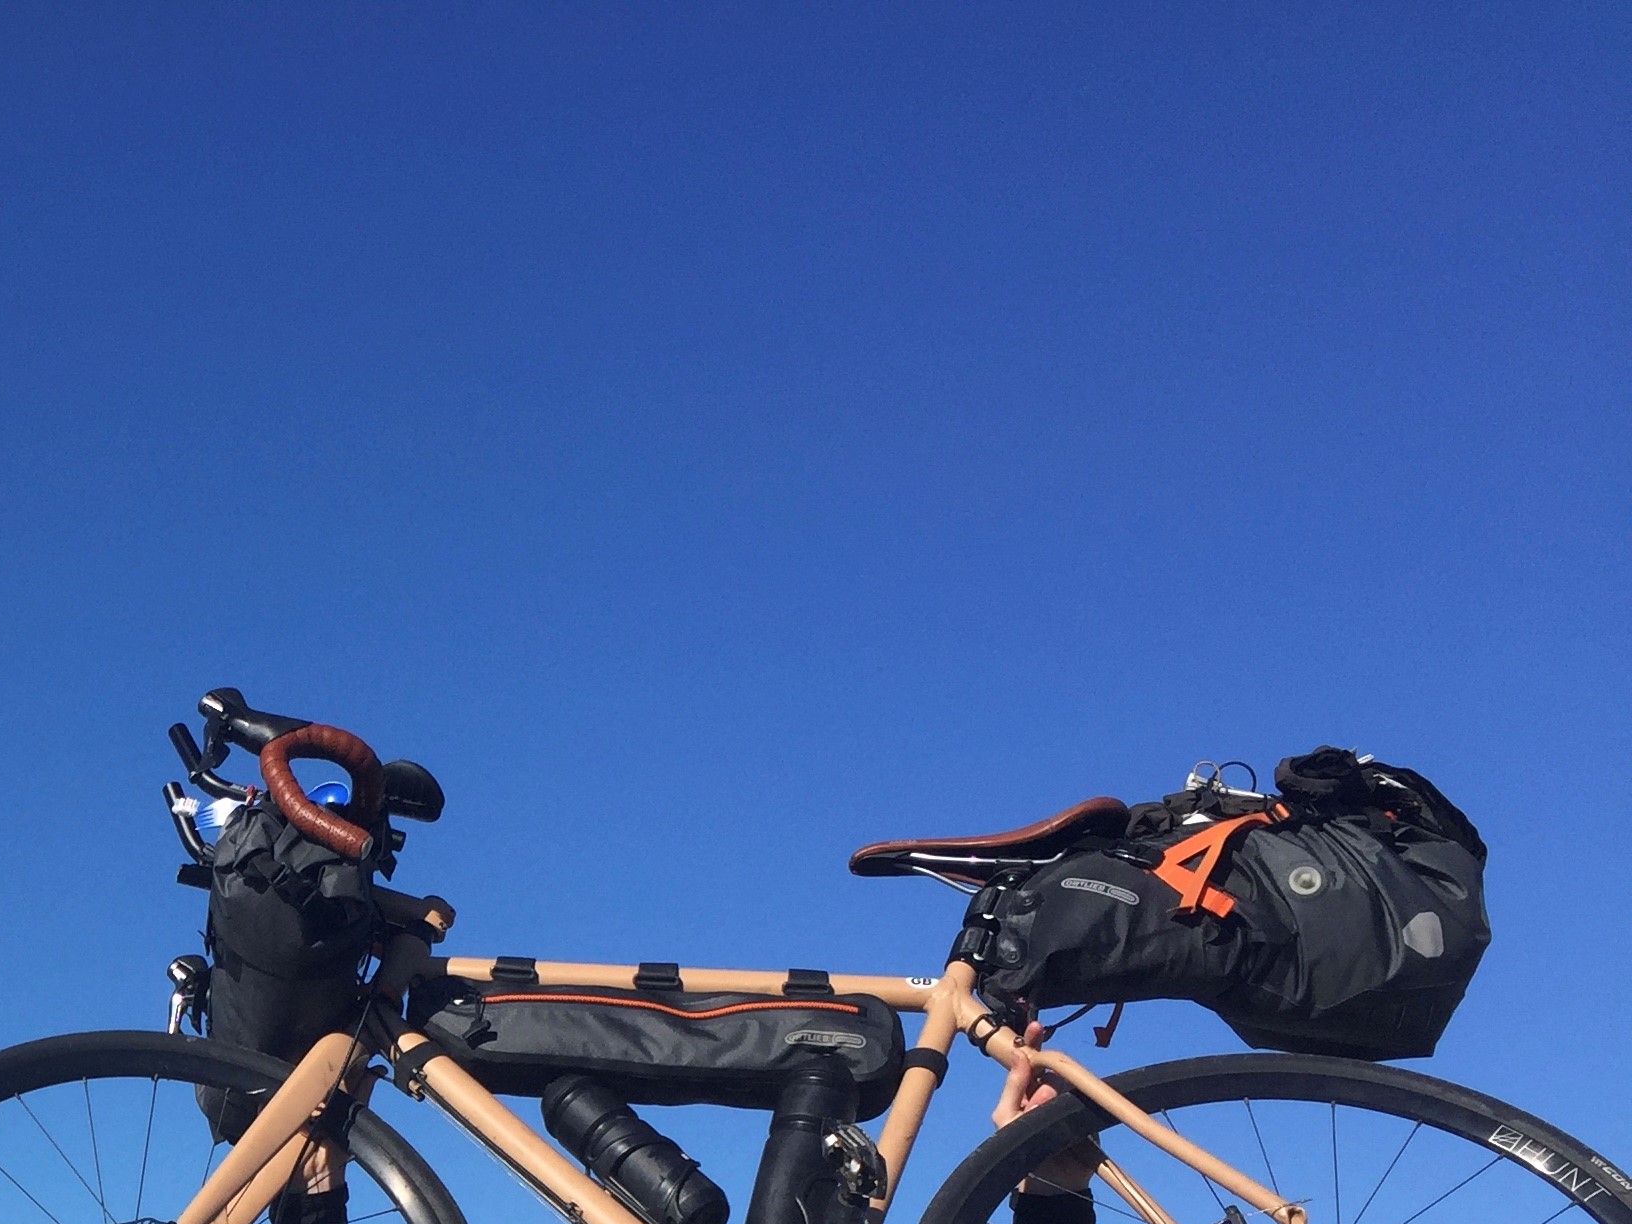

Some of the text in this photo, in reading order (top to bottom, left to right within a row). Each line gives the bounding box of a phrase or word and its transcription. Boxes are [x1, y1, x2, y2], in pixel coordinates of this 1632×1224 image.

[910, 977, 932, 986] GB
[1518, 1138, 1612, 1202] HUNT
[1602, 1165, 1632, 1191] CON
